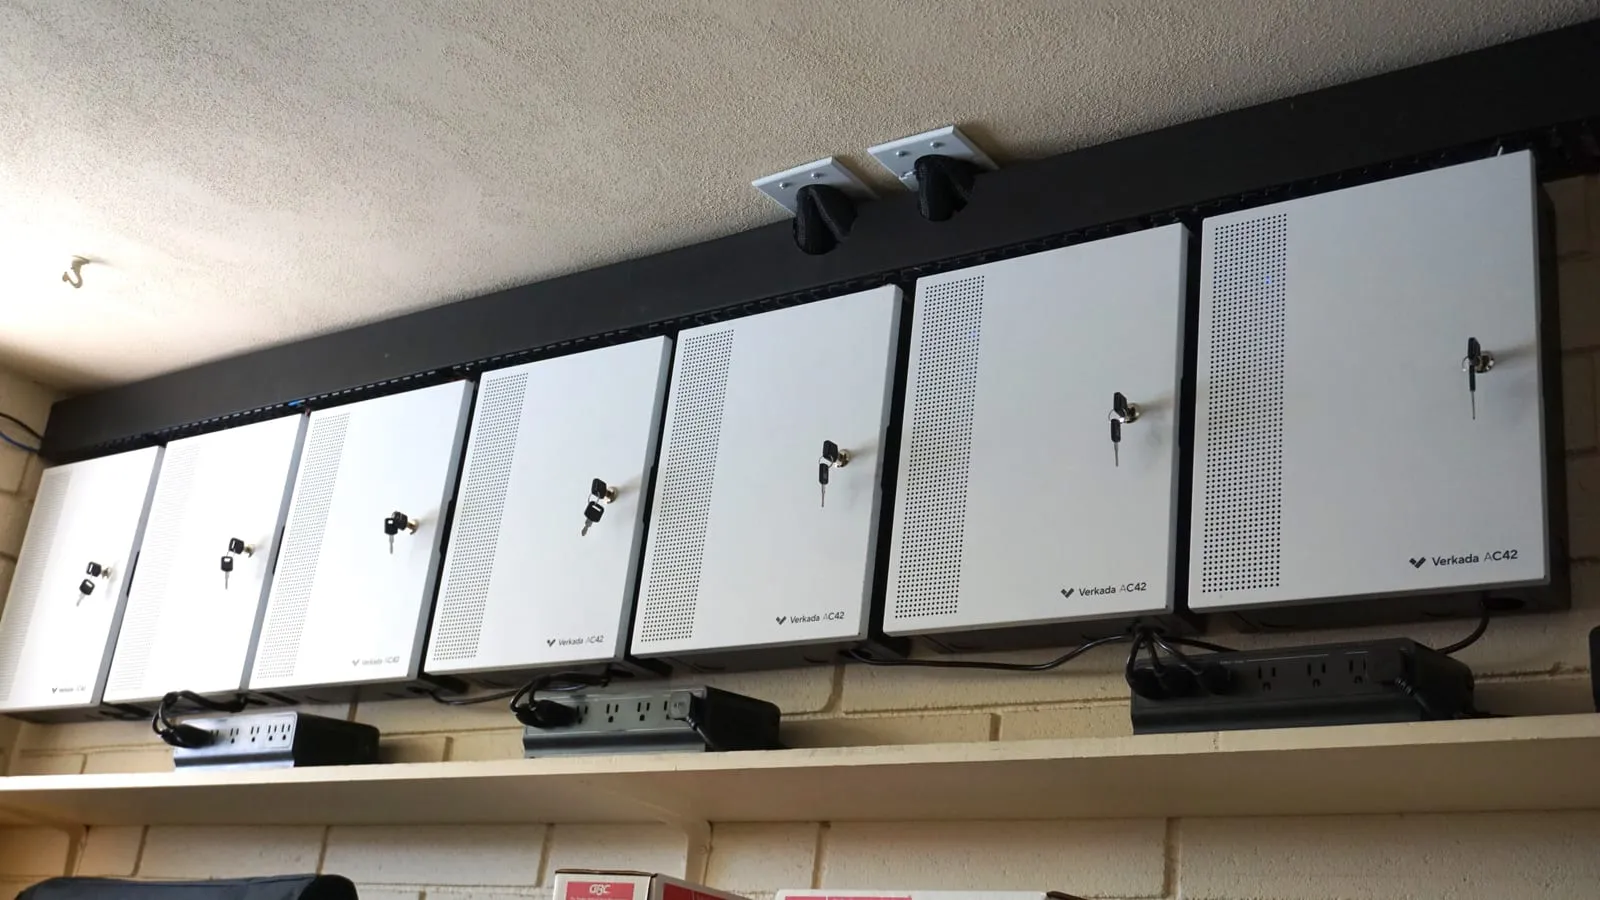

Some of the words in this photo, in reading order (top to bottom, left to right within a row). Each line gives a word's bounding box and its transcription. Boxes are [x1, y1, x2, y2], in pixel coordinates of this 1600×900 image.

[1432, 554, 1479, 566] Verkada
[1484, 549, 1518, 562] AC42
[1079, 586, 1116, 596] Verkada
[1119, 582, 1147, 593] AC42
[790, 614, 820, 624] Verkada
[823, 611, 845, 620] AC42
